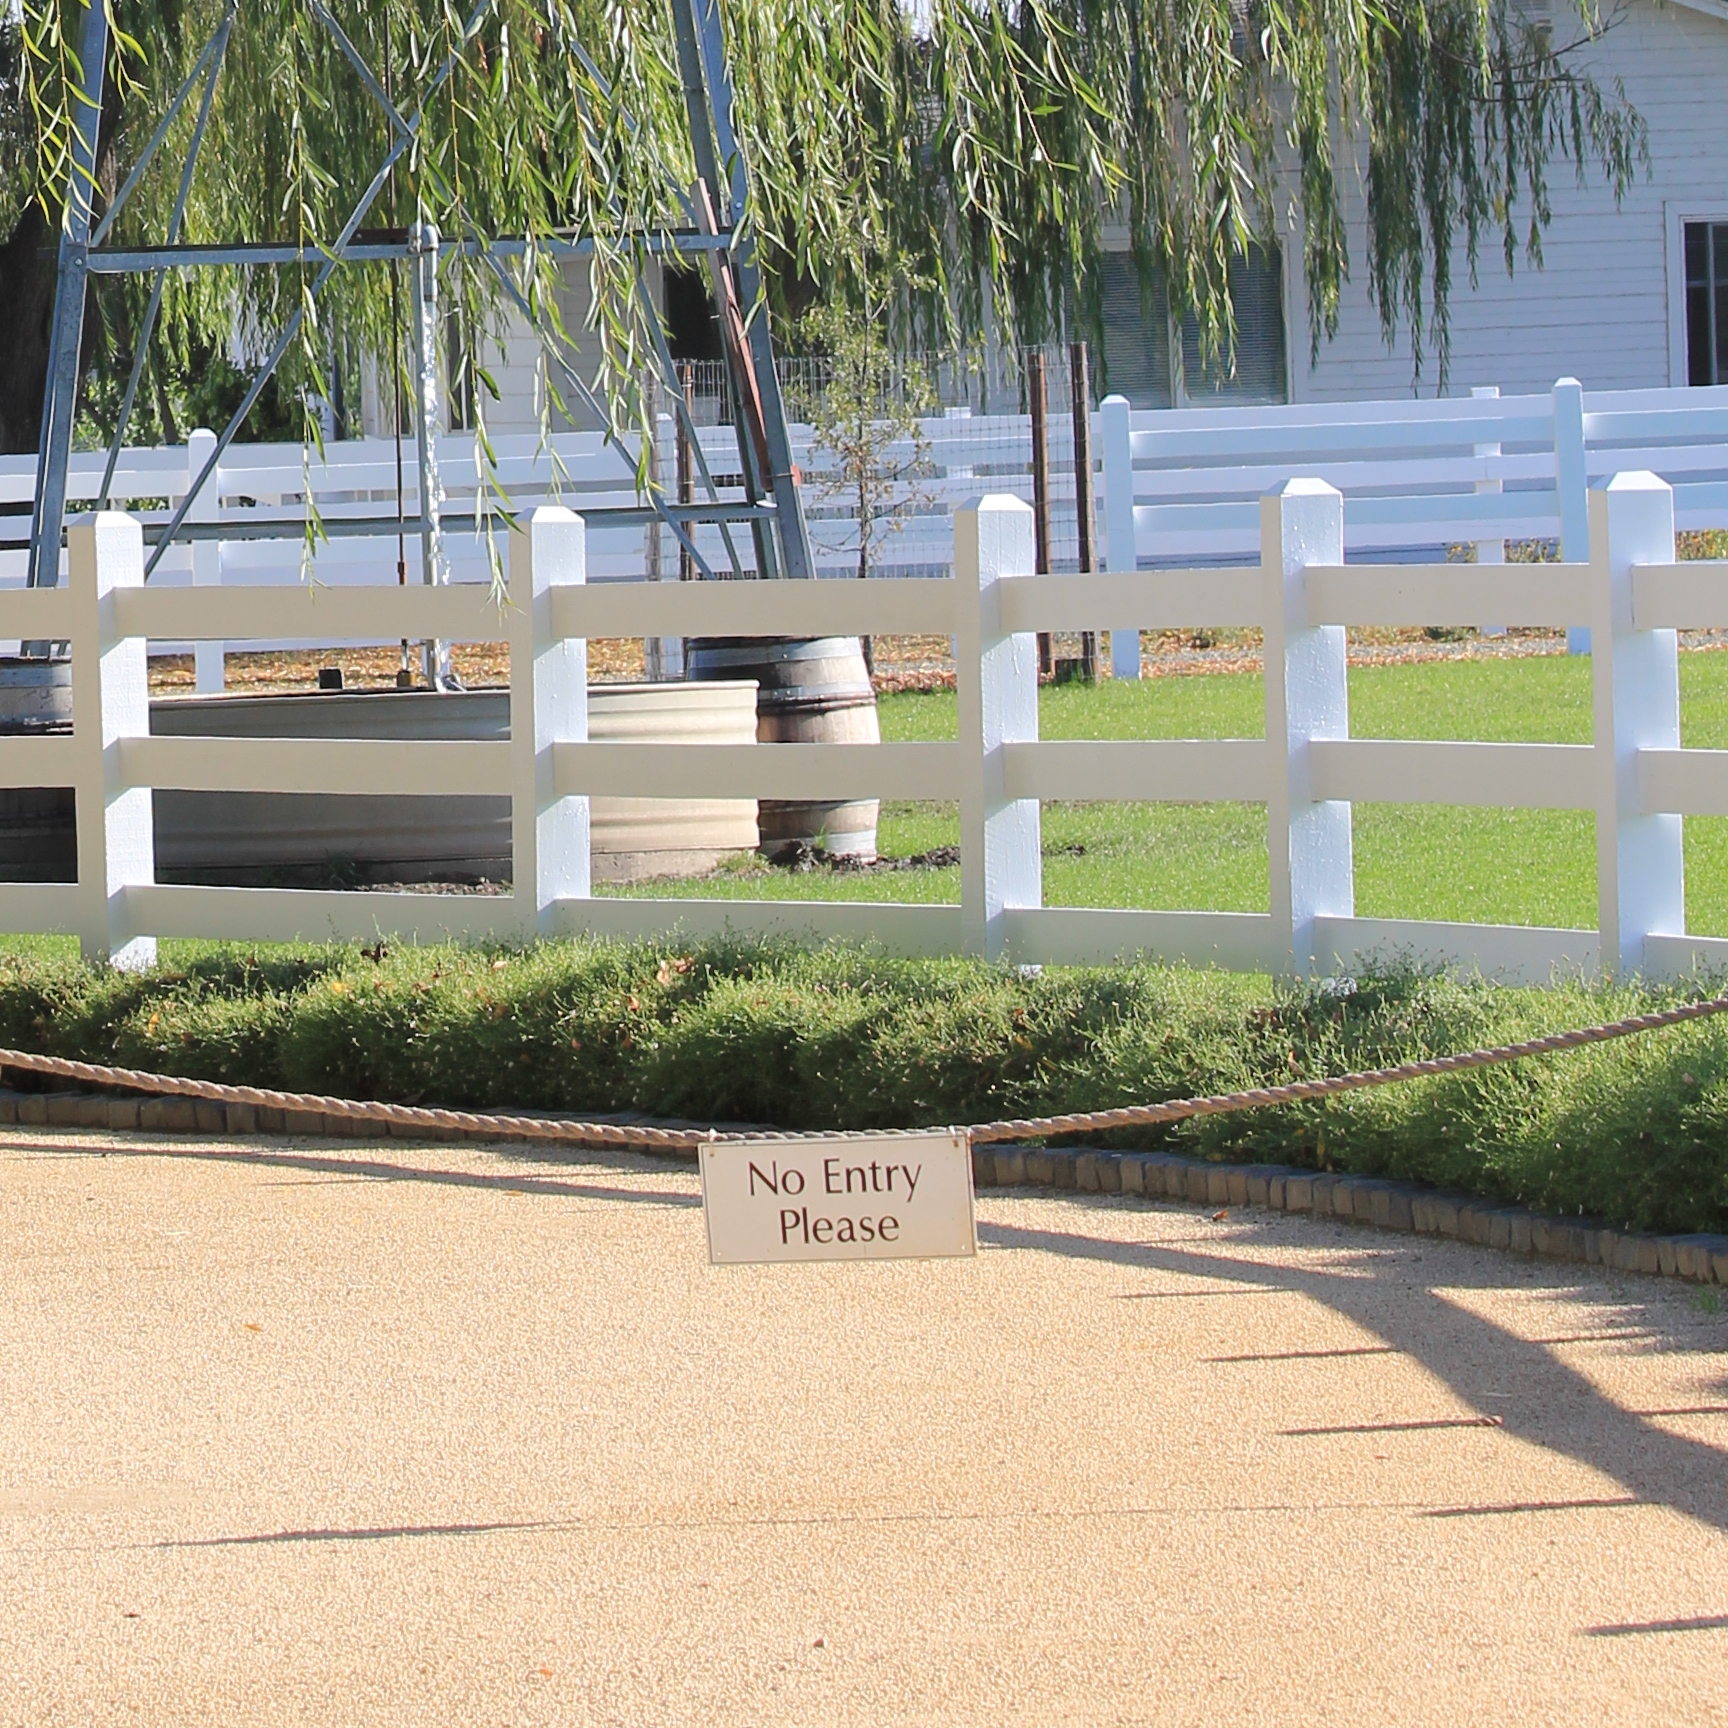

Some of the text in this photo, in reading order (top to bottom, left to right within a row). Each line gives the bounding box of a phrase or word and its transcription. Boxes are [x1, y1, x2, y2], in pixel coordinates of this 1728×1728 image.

[747, 1157, 922, 1203] No Entry
[779, 1206, 900, 1244] Please
